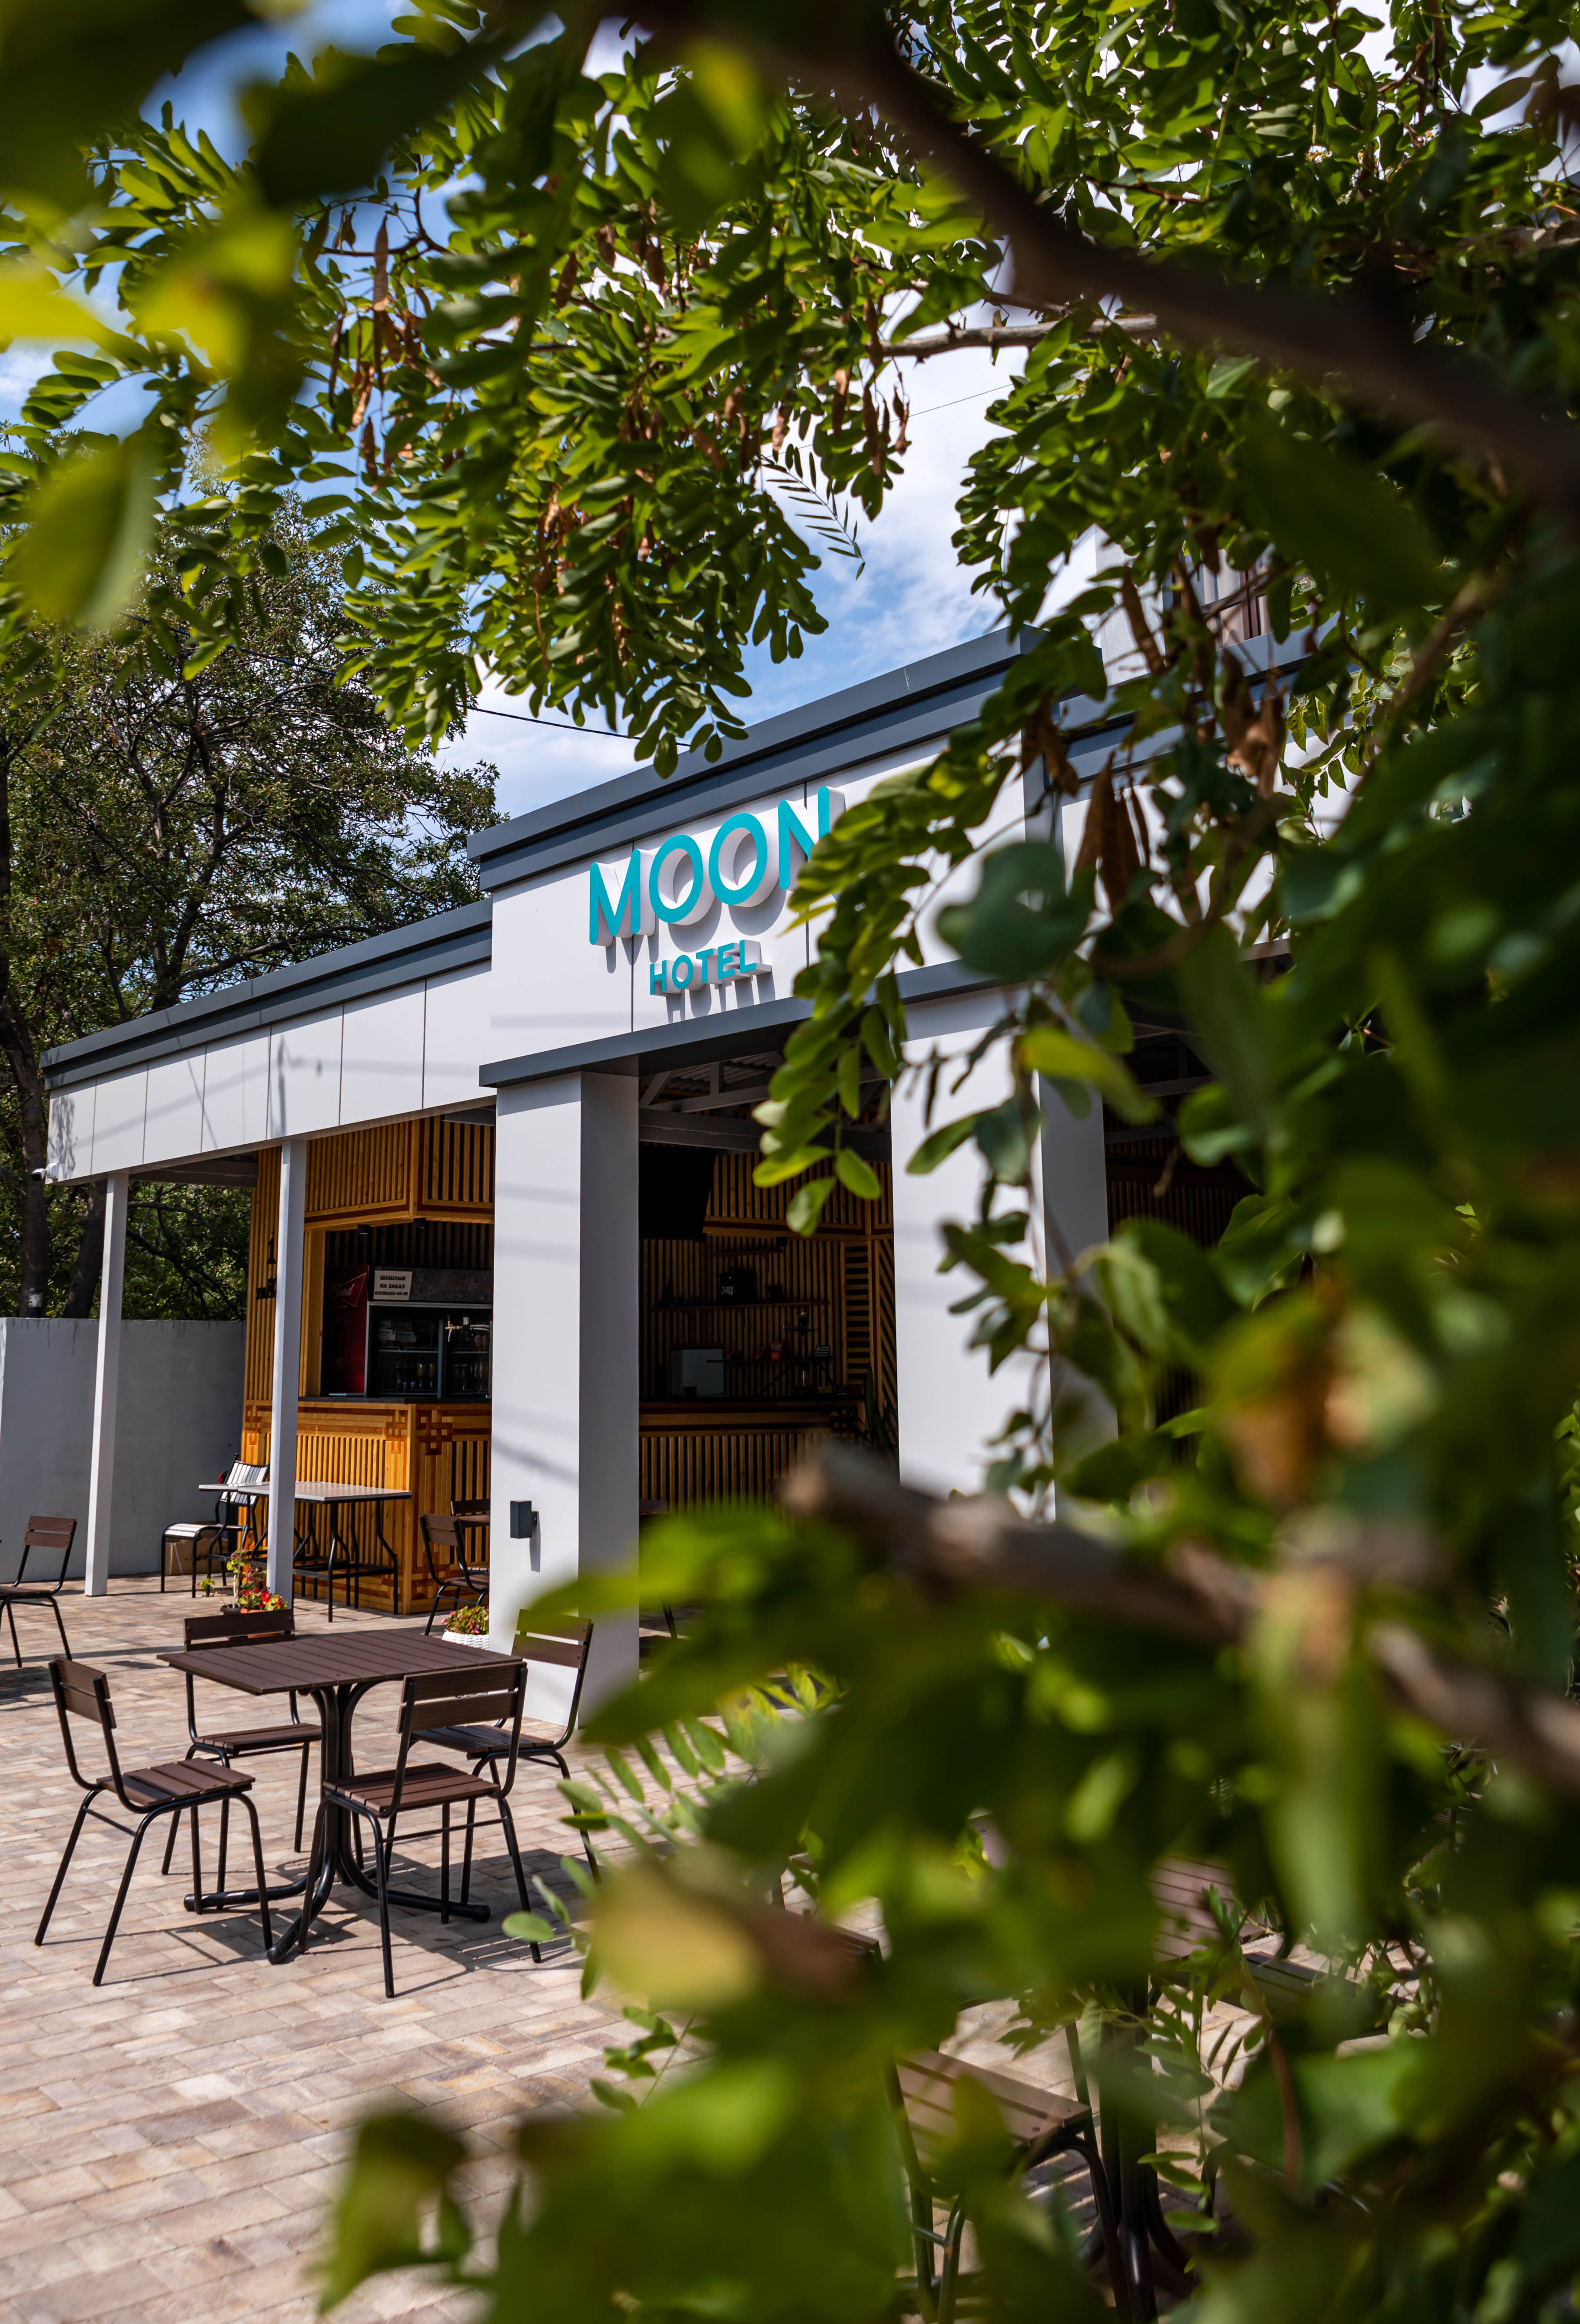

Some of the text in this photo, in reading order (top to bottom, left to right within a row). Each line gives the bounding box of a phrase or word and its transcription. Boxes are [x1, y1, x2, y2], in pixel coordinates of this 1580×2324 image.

[589, 786, 830, 945] MOON
[650, 940, 756, 995] HOTEL
[329, 1283, 355, 1298] Bud
